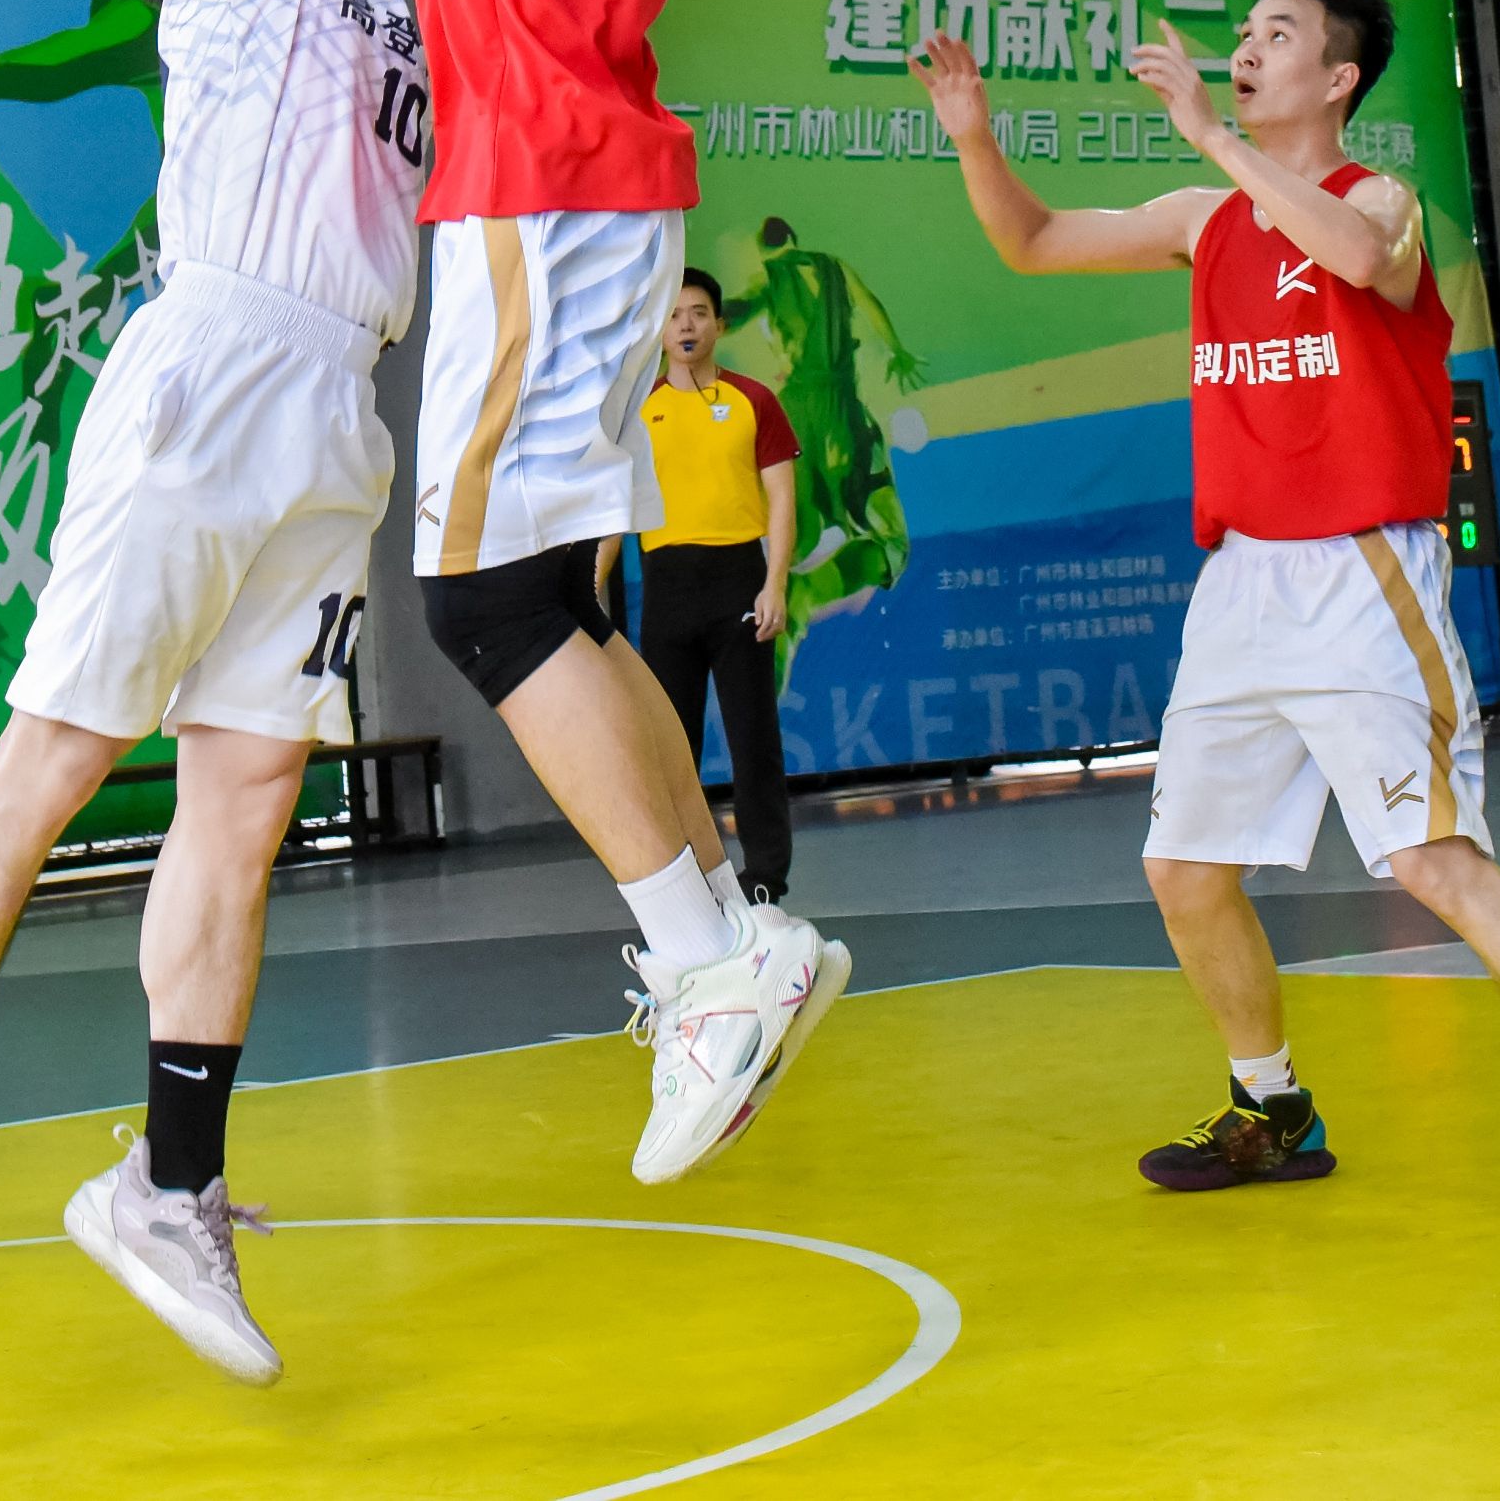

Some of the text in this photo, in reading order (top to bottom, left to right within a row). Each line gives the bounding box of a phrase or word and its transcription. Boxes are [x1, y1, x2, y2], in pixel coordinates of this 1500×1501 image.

[375, 67, 428, 168] 10
[1193, 331, 1341, 386] 科凡定制
[301, 592, 367, 680] 10
[700, 656, 1180, 780] SKETBA
